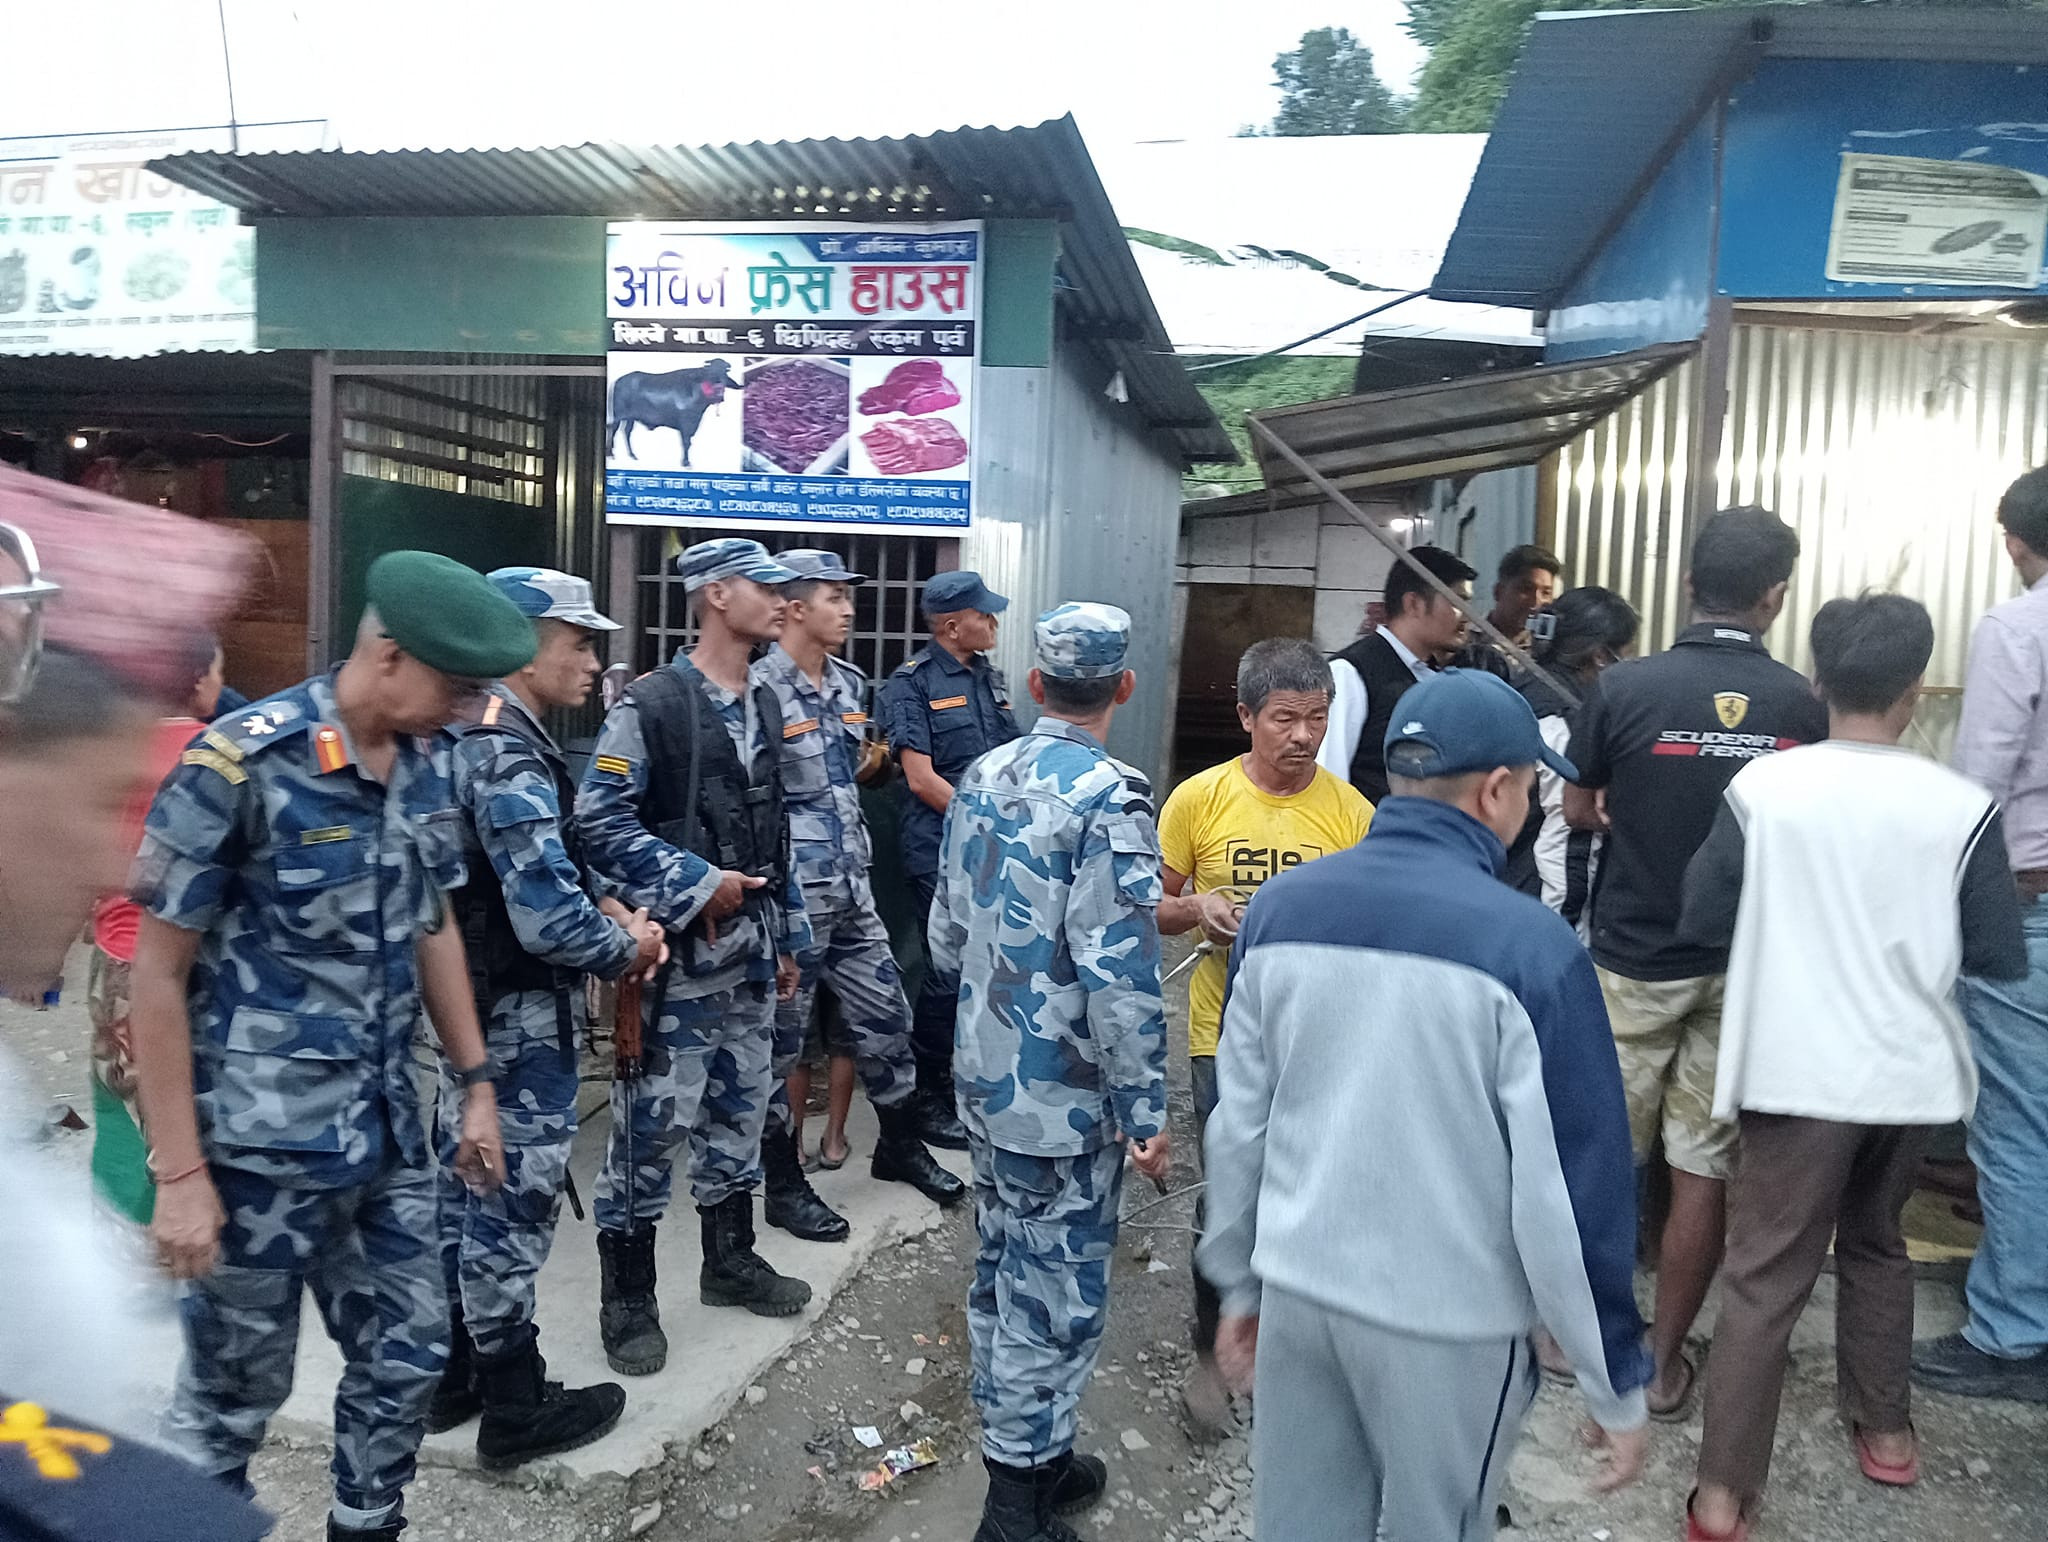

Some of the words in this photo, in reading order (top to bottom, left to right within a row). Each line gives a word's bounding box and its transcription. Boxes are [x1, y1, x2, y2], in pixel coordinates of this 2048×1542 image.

[747, 252, 836, 315] फ्रेस
[850, 264, 970, 315] हाउस
[1658, 730, 1777, 747] SCUDERIA
